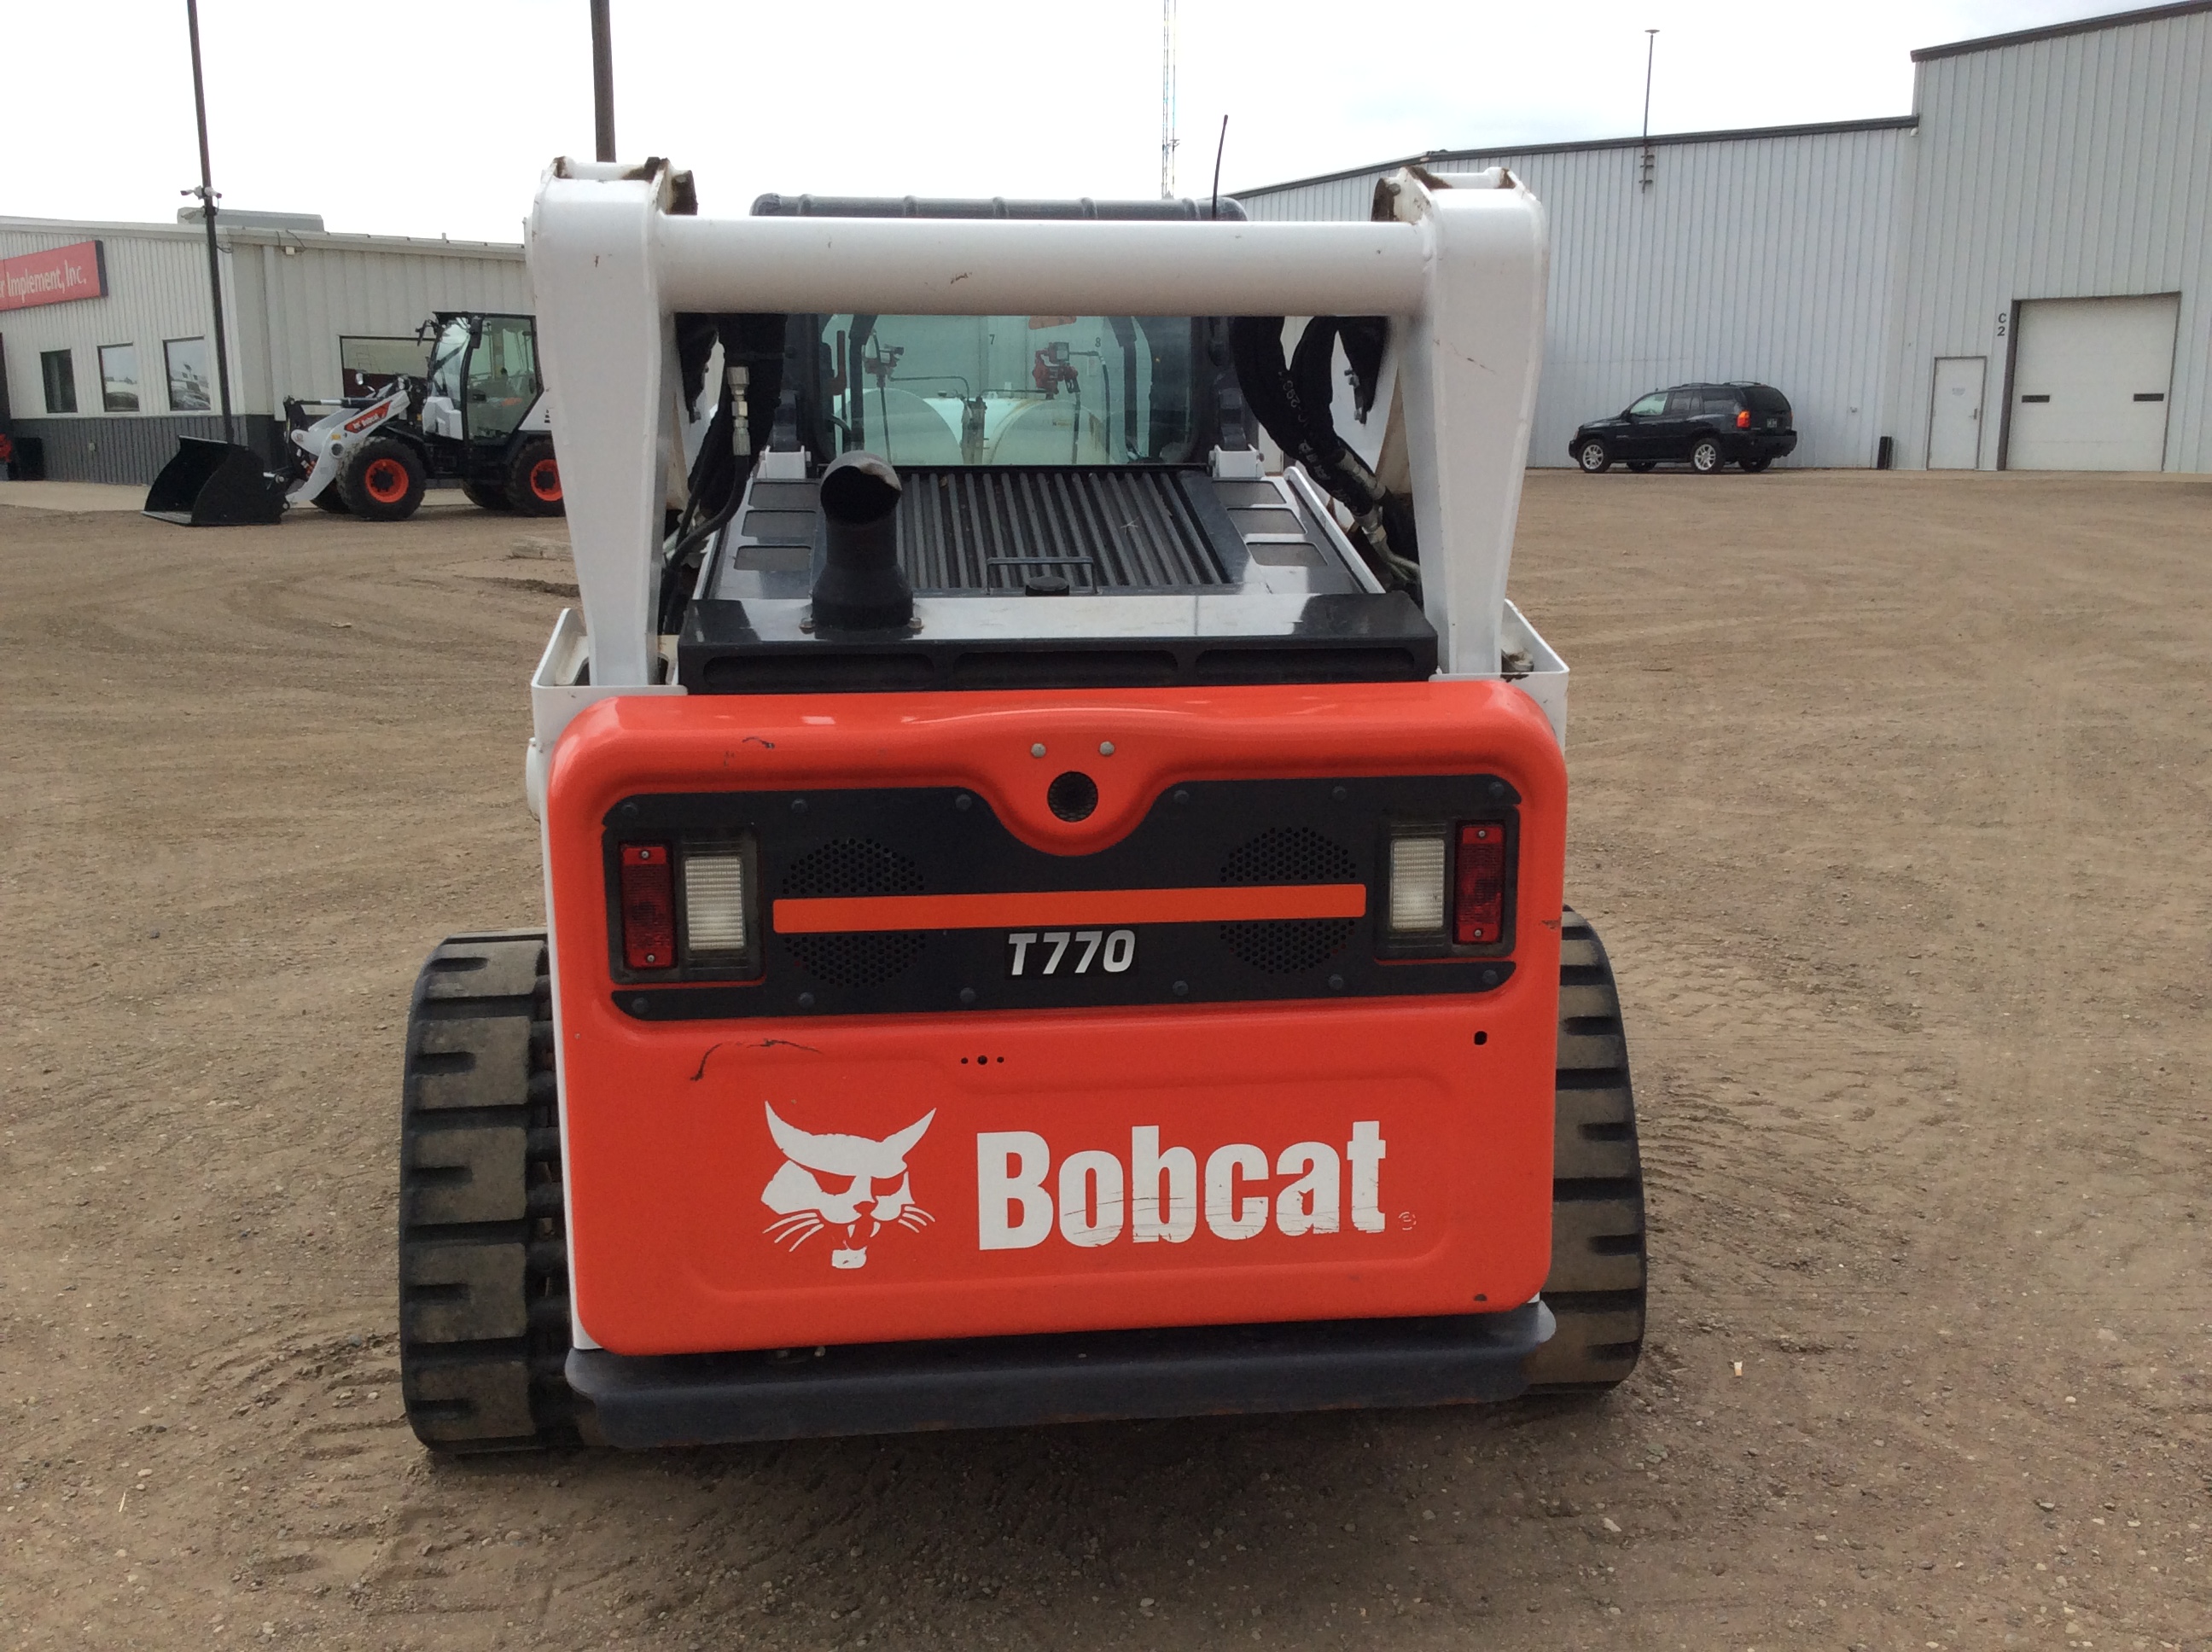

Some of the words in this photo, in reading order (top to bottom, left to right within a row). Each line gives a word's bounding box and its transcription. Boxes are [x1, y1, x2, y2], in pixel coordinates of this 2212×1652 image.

[6, 267, 66, 303] Implement,
[65, 259, 87, 287] Inc.
[989, 334, 996, 345] 7
[1095, 337, 1102, 348] 8
[1008, 928, 1136, 976] T770
[976, 1120, 1387, 1251] Bobcat
